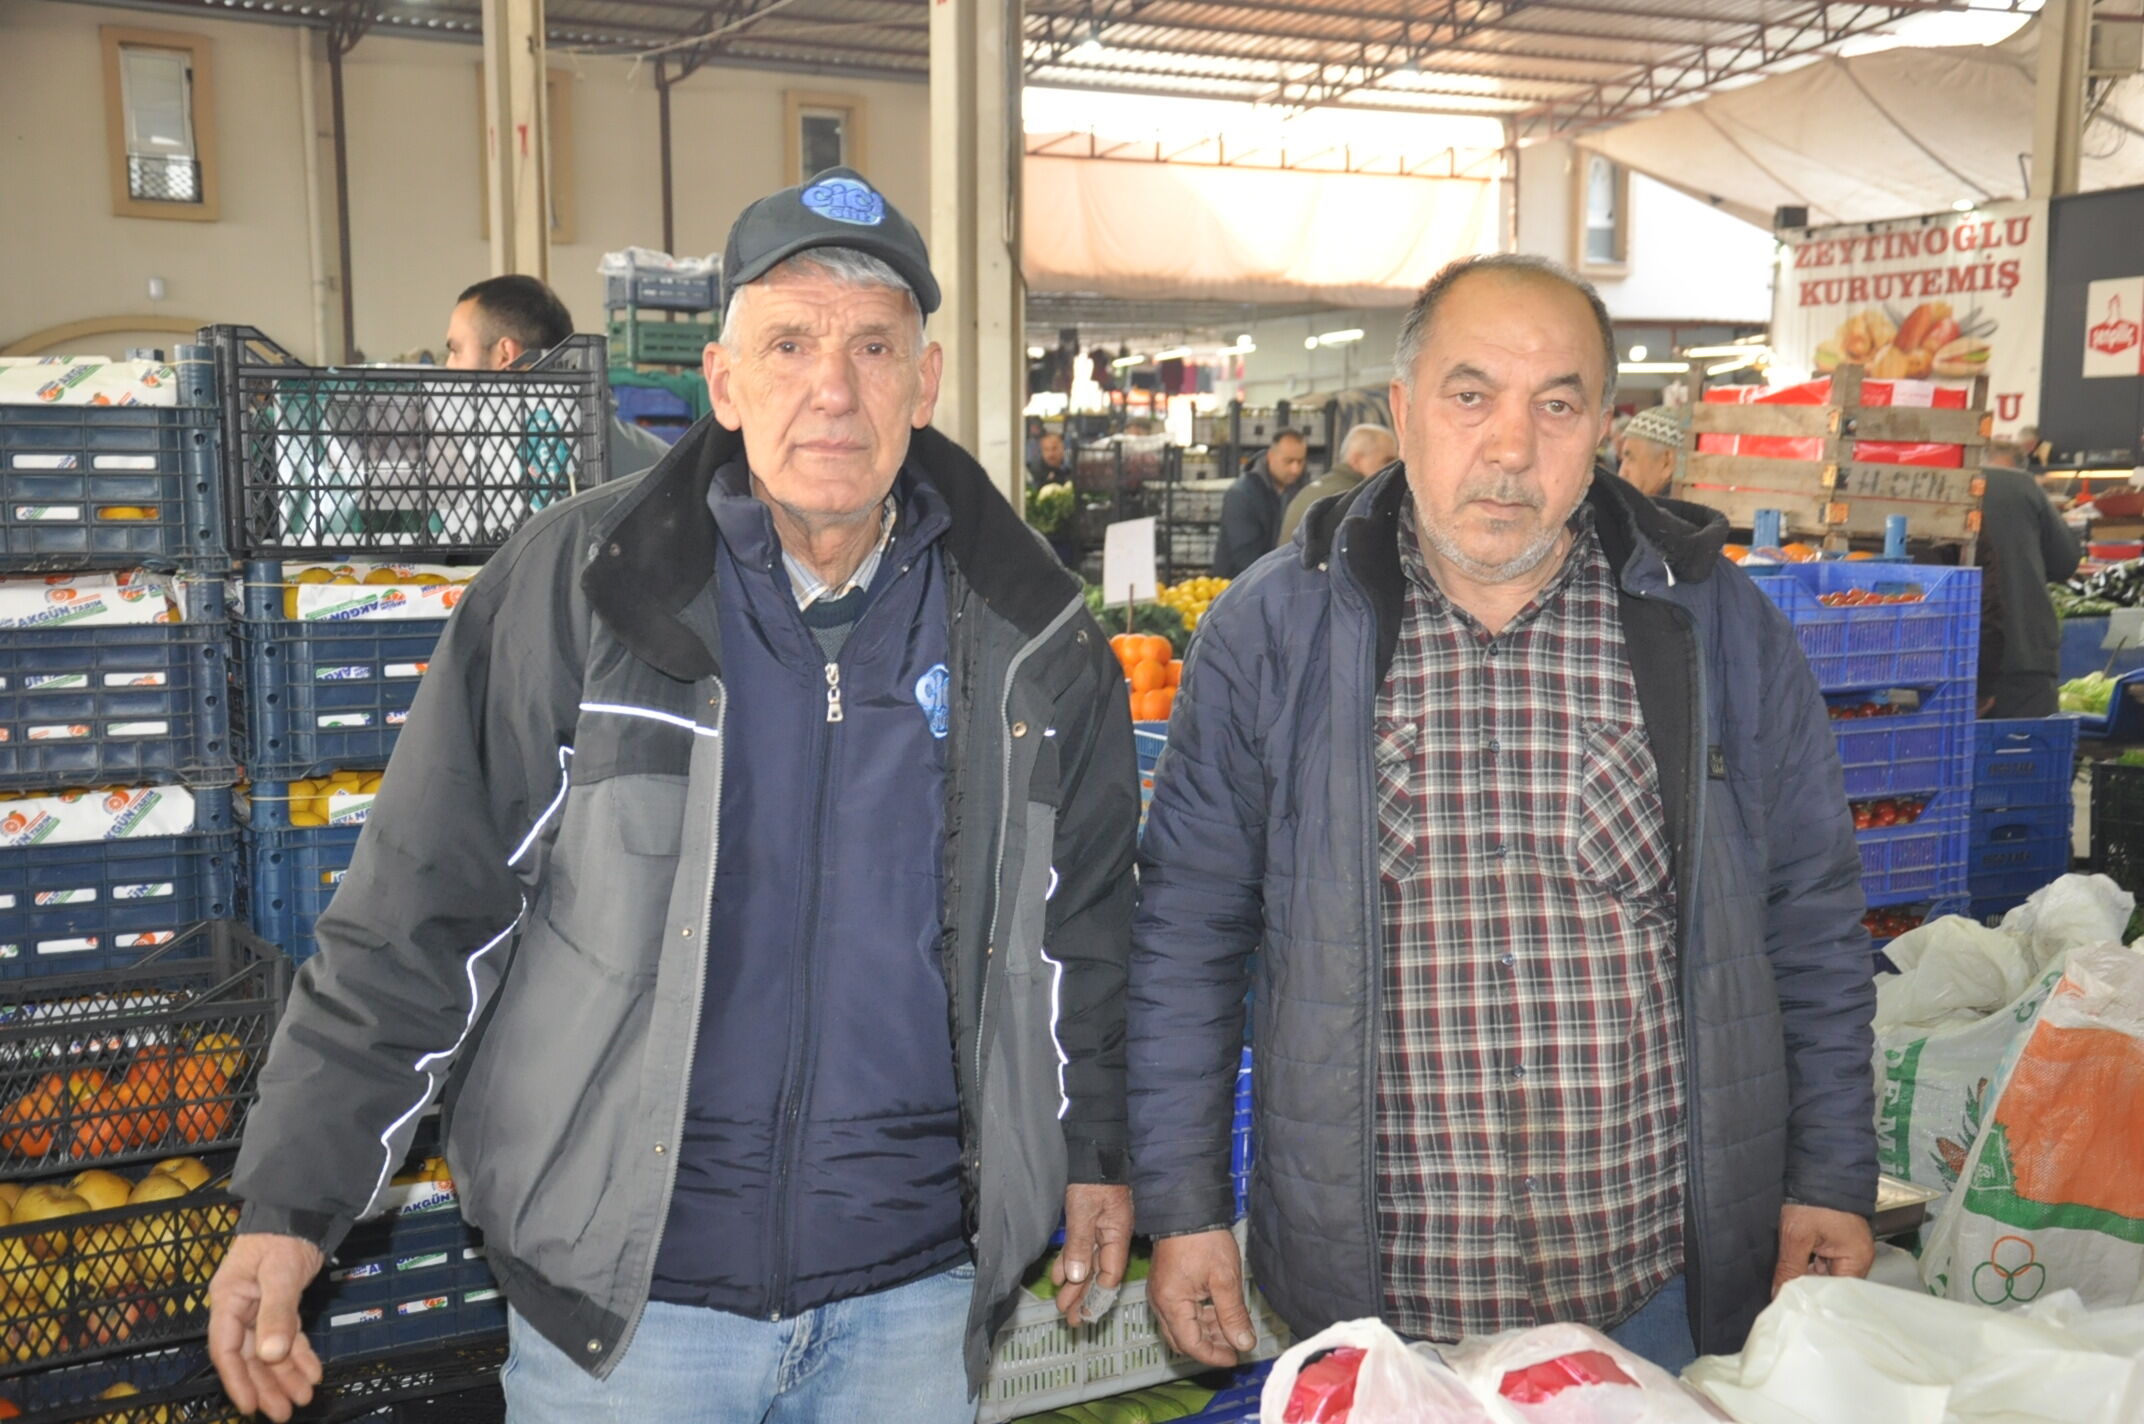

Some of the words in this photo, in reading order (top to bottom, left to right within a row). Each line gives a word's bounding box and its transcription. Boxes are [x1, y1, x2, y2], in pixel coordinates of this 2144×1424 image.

[1795, 214, 2031, 268] ZEYTİNOĞLU
[1799, 254, 2021, 307] KURUYEMİŞ
[18, 605, 70, 627] AKGÜN
[403, 1193, 450, 1214] AKGÜN
